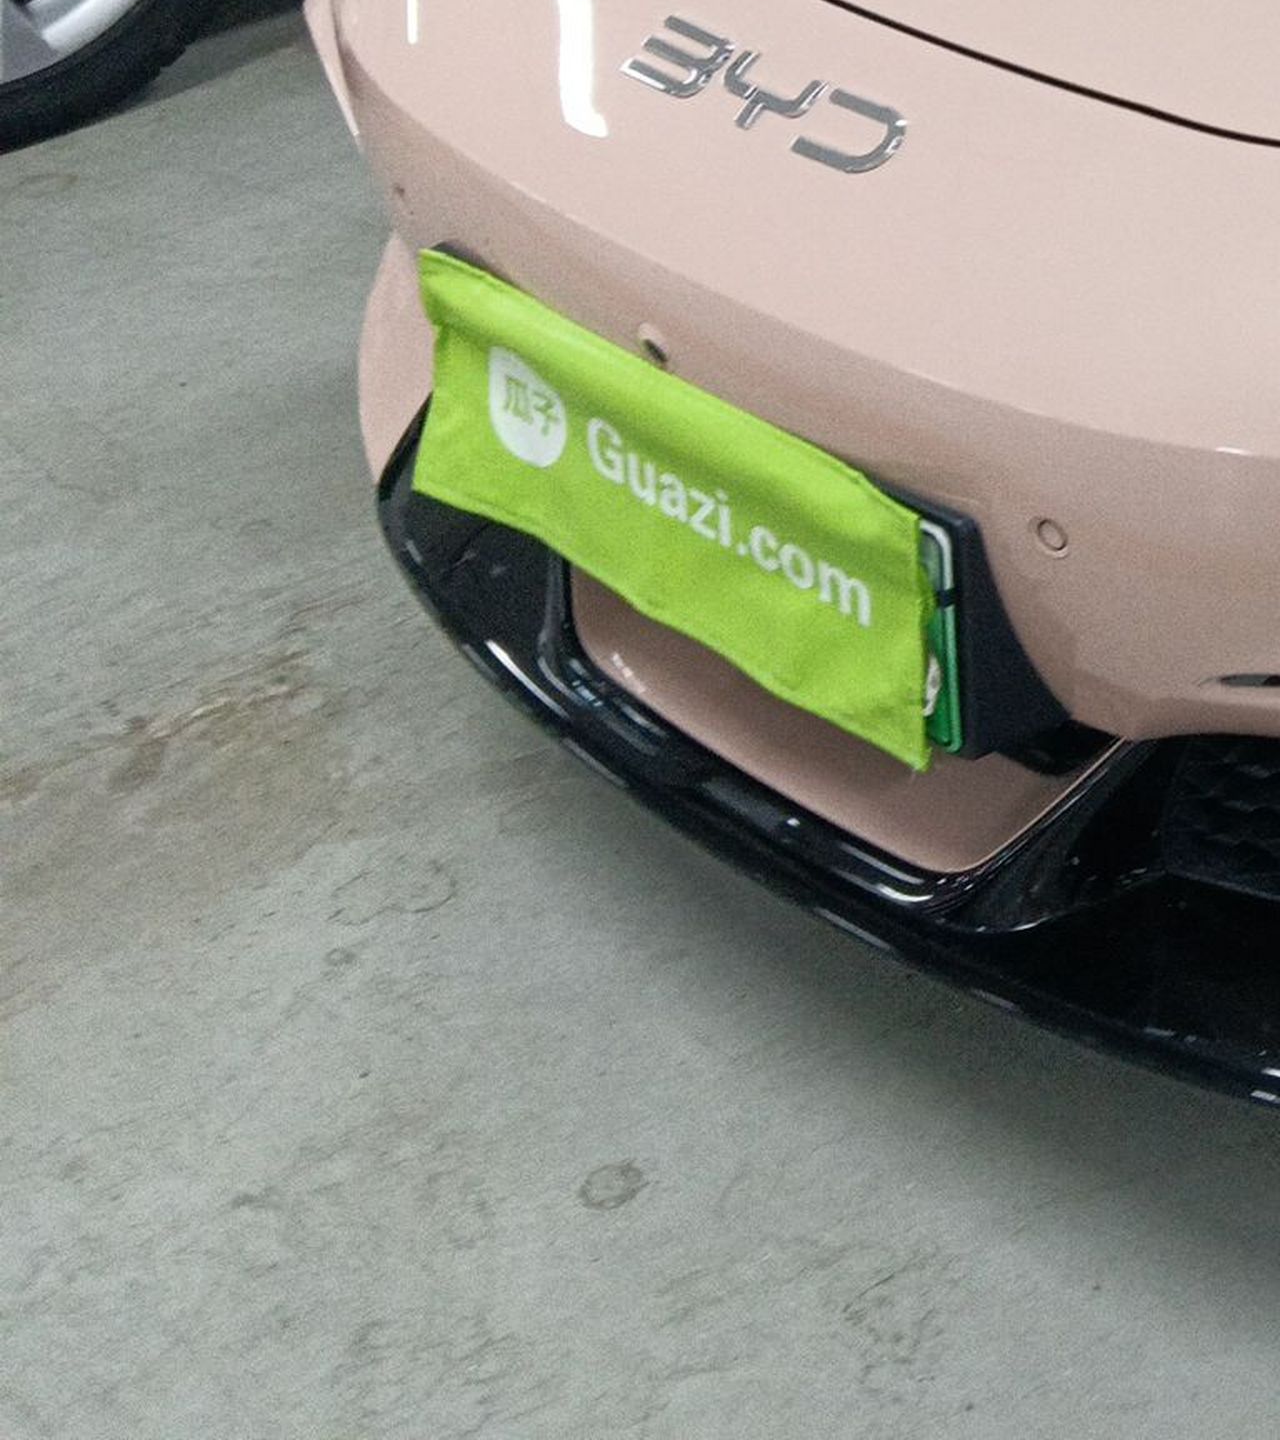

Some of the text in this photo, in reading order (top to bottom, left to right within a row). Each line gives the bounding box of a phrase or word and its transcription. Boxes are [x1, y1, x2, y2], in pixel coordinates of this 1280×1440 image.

[620, 15, 907, 174] BYD
[503, 374, 560, 437] 瓜子
[587, 417, 870, 628] Guazi.com
